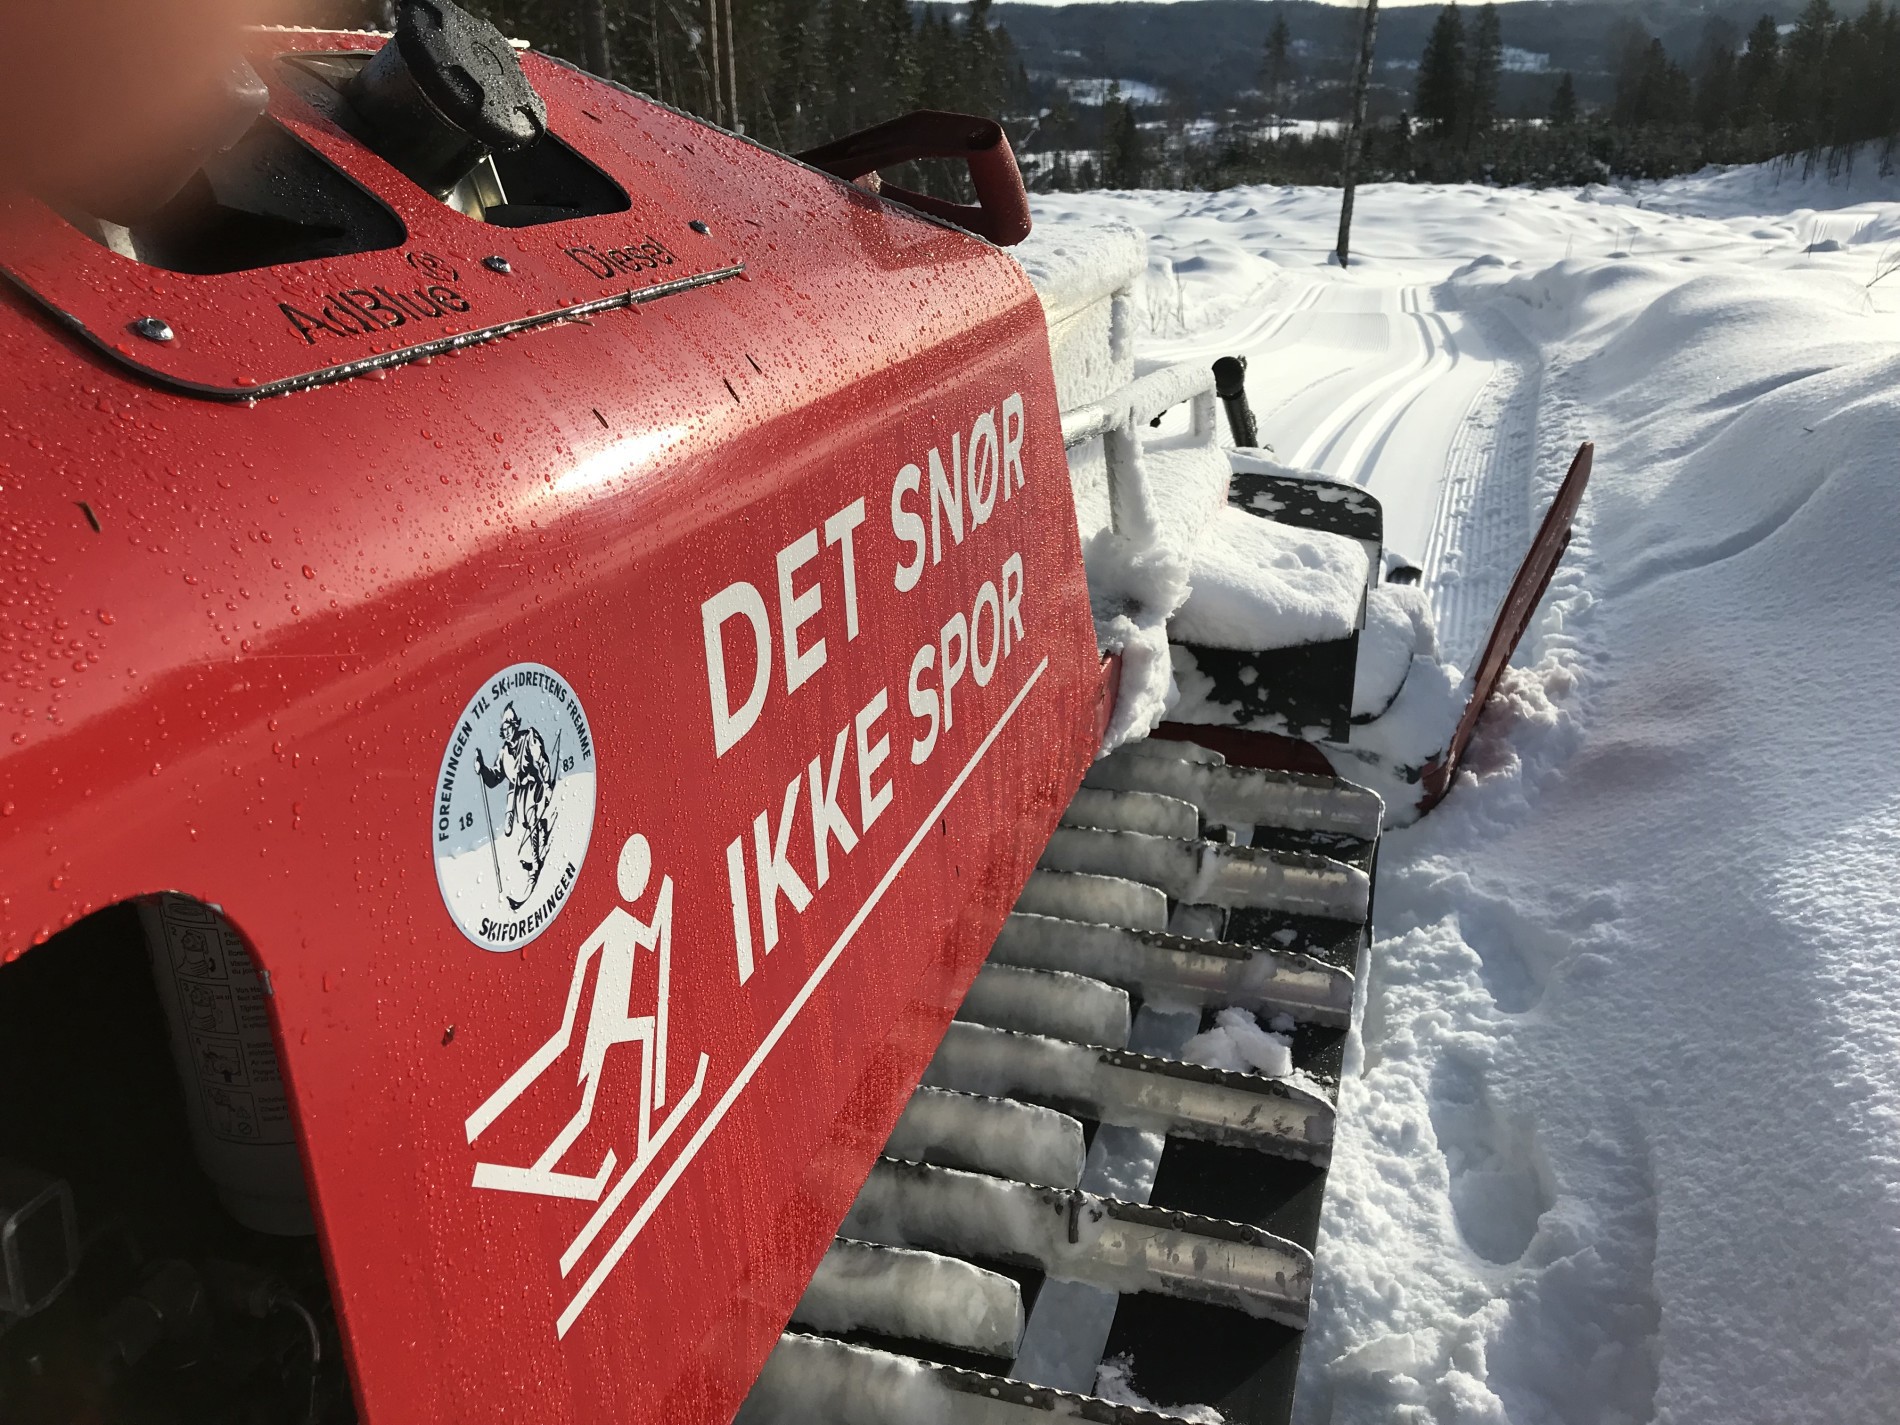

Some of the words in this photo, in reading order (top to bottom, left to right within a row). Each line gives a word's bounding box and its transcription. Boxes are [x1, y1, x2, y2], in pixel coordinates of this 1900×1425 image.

[563, 234, 681, 280] Diesel
[701, 497, 866, 759] DET
[891, 392, 1025, 593] SNØR
[438, 721, 473, 842] FORENINGEN
[471, 697, 490, 720] TIL
[491, 671, 568, 703] SKI-IDRETTENS
[567, 699, 592, 761] FREMME
[563, 756, 575, 773] 83
[726, 686, 894, 987] IKKE
[908, 551, 1025, 765] SPOR
[458, 811, 474, 831] 18
[479, 862, 576, 941] SKIFORENINGEN
